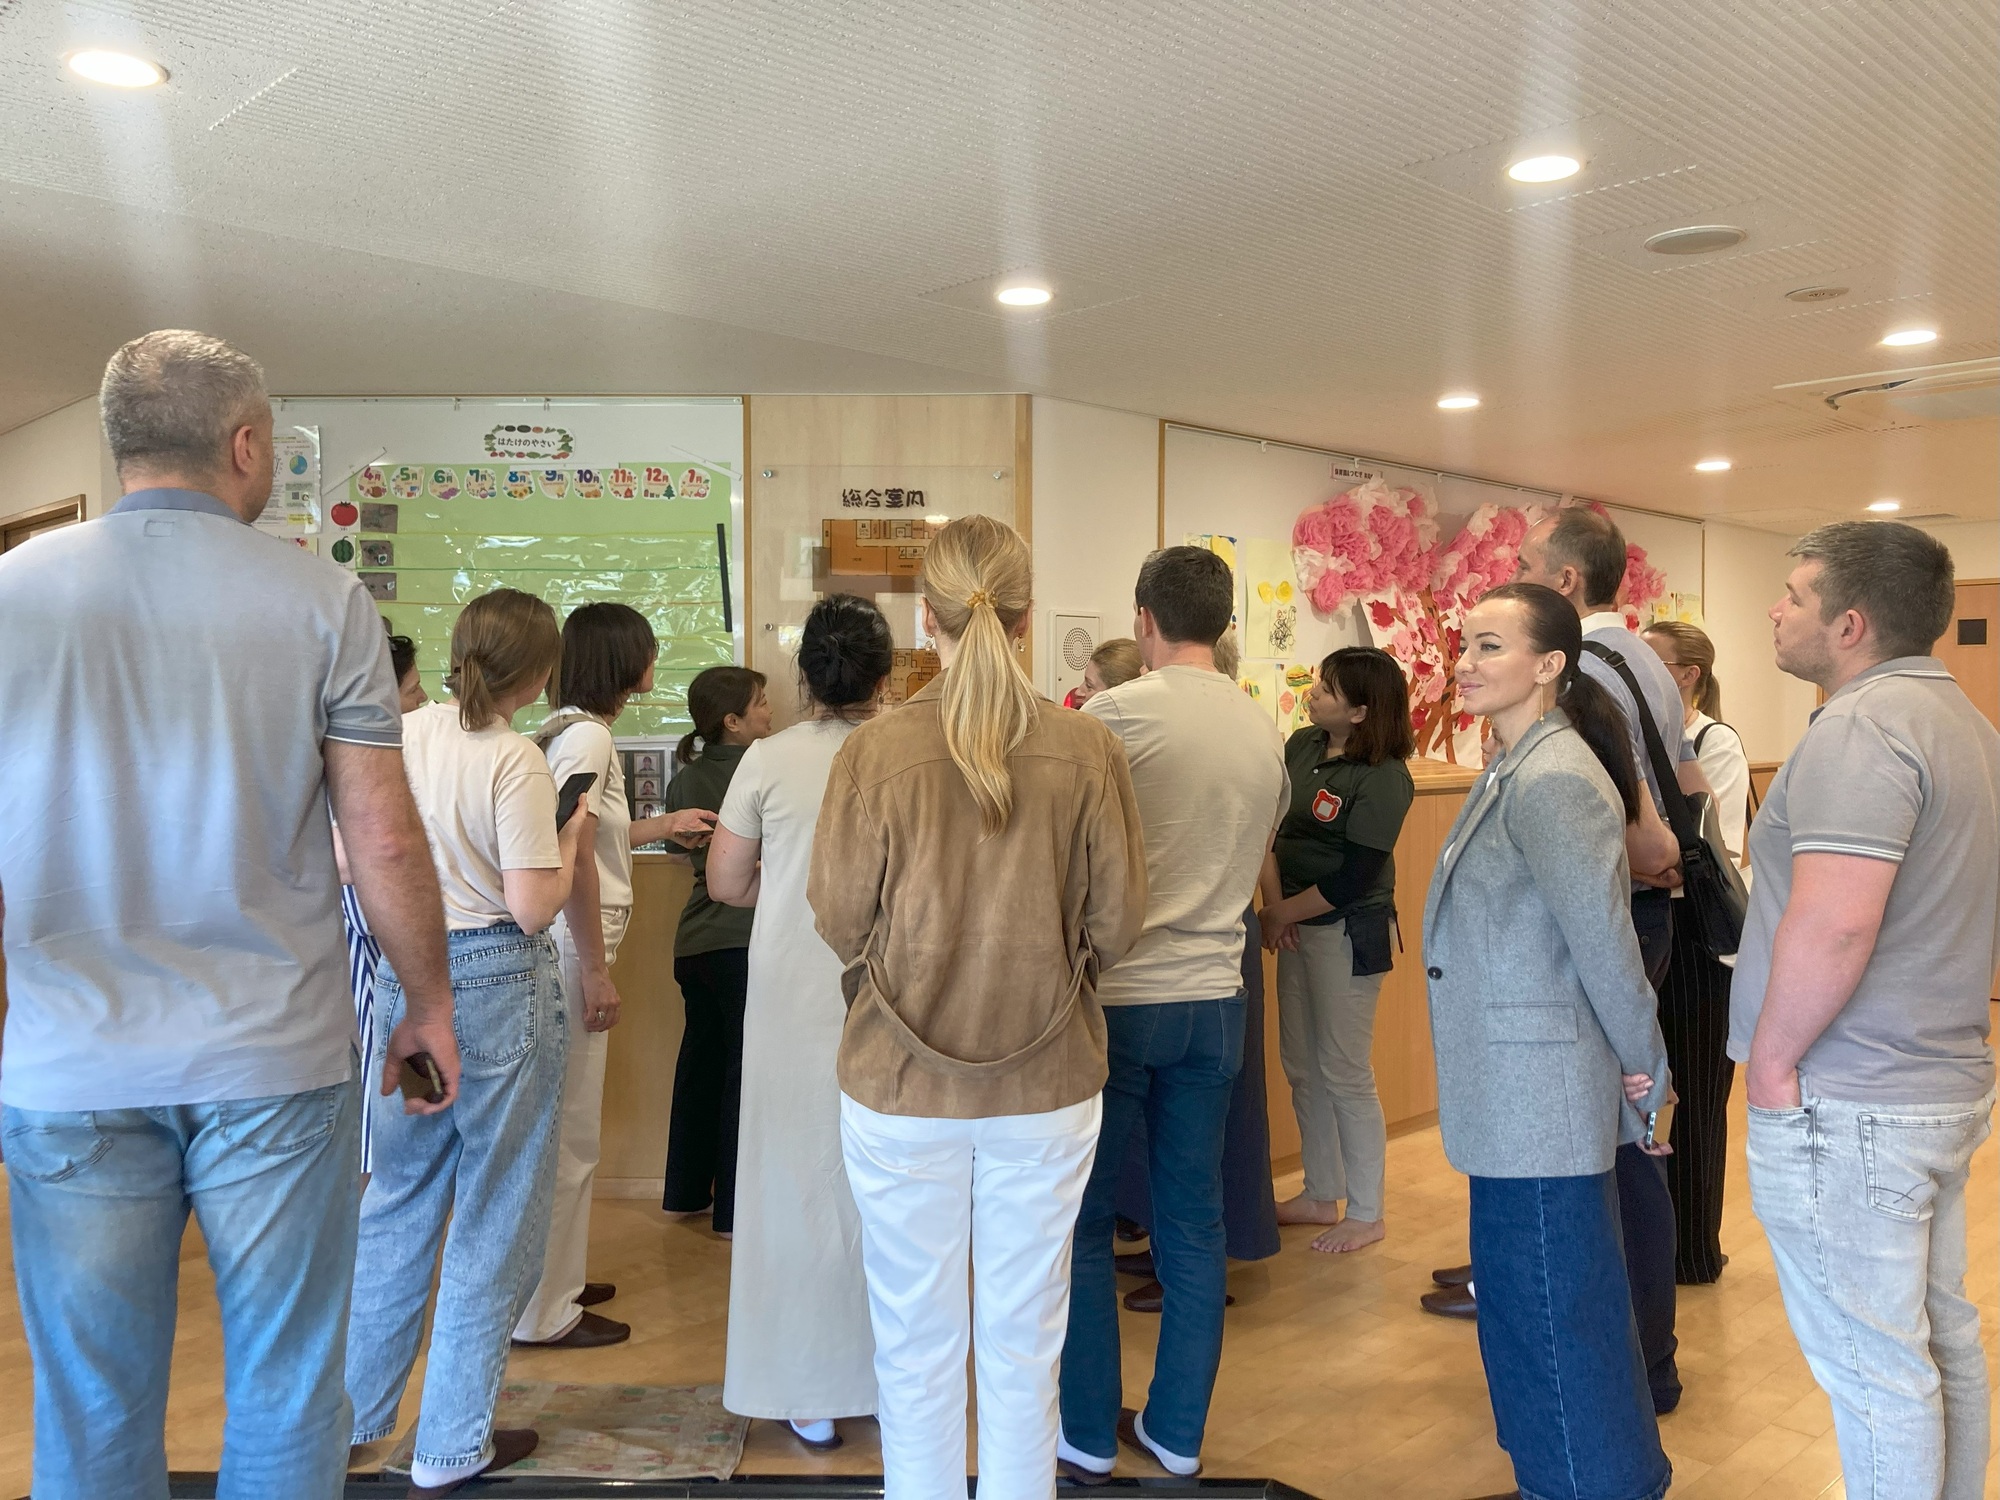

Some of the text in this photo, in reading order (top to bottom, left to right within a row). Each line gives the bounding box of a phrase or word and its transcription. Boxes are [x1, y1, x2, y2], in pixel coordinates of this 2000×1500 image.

[498, 437, 556, 449] はたけのやさい
[364, 467, 381, 481] 4月
[400, 467, 418, 481] 5月
[434, 469, 453, 483] 6月
[469, 469, 487, 482] 7月
[508, 471, 526, 483] 8月
[545, 470, 564, 481] 9月
[577, 469, 600, 483] 10月
[613, 468, 633, 483] 11月
[645, 467, 669, 482] 12月
[688, 469, 702, 483] 1月
[842, 488, 925, 508] 総合案内
